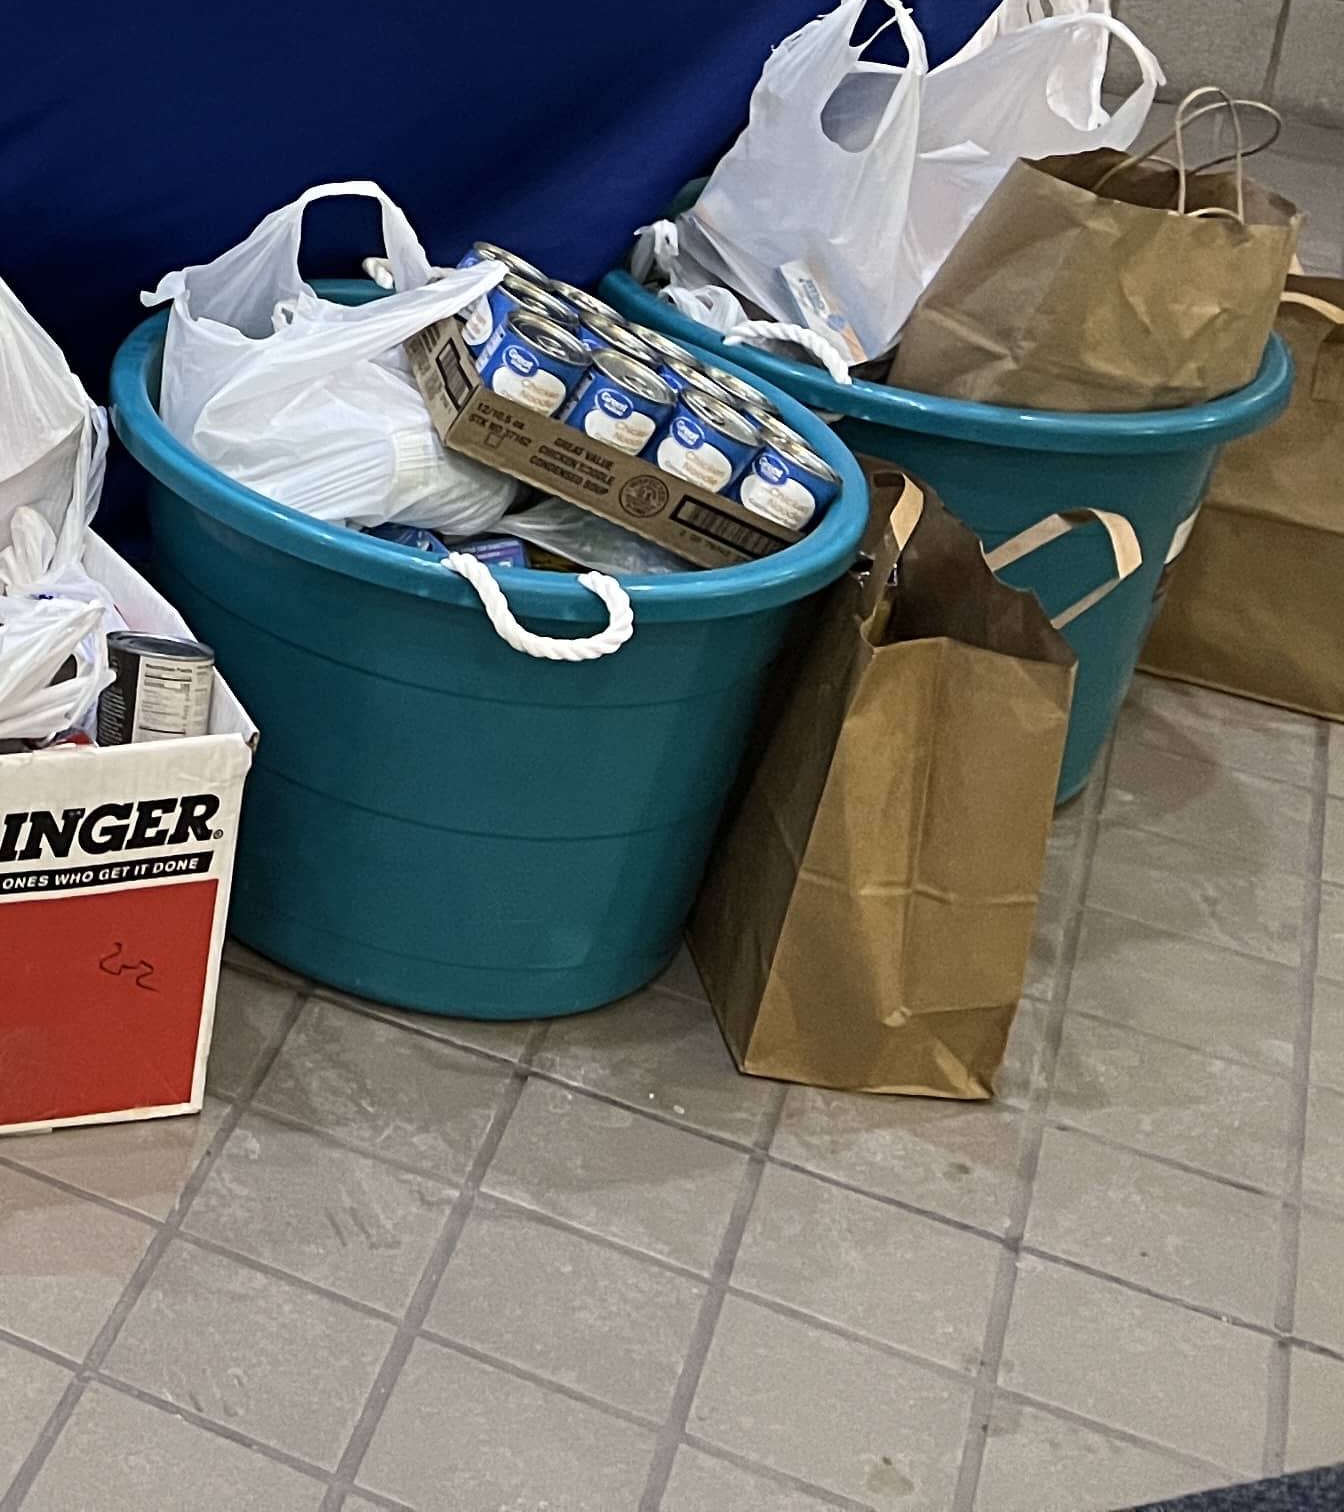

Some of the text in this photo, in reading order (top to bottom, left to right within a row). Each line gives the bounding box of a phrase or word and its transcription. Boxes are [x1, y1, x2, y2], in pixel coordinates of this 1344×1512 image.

[601, 392, 628, 410] Great
[538, 445, 577, 471] CHICKEN
[554, 438, 615, 469] GREAT VALUE
[530, 455, 583, 490] CONDENSED
[2, 875, 50, 890] ONES
[55, 871, 93, 886] WHO
[98, 867, 130, 881] GET
[134, 864, 149, 876] IT
[152, 858, 200, 874] DONE
